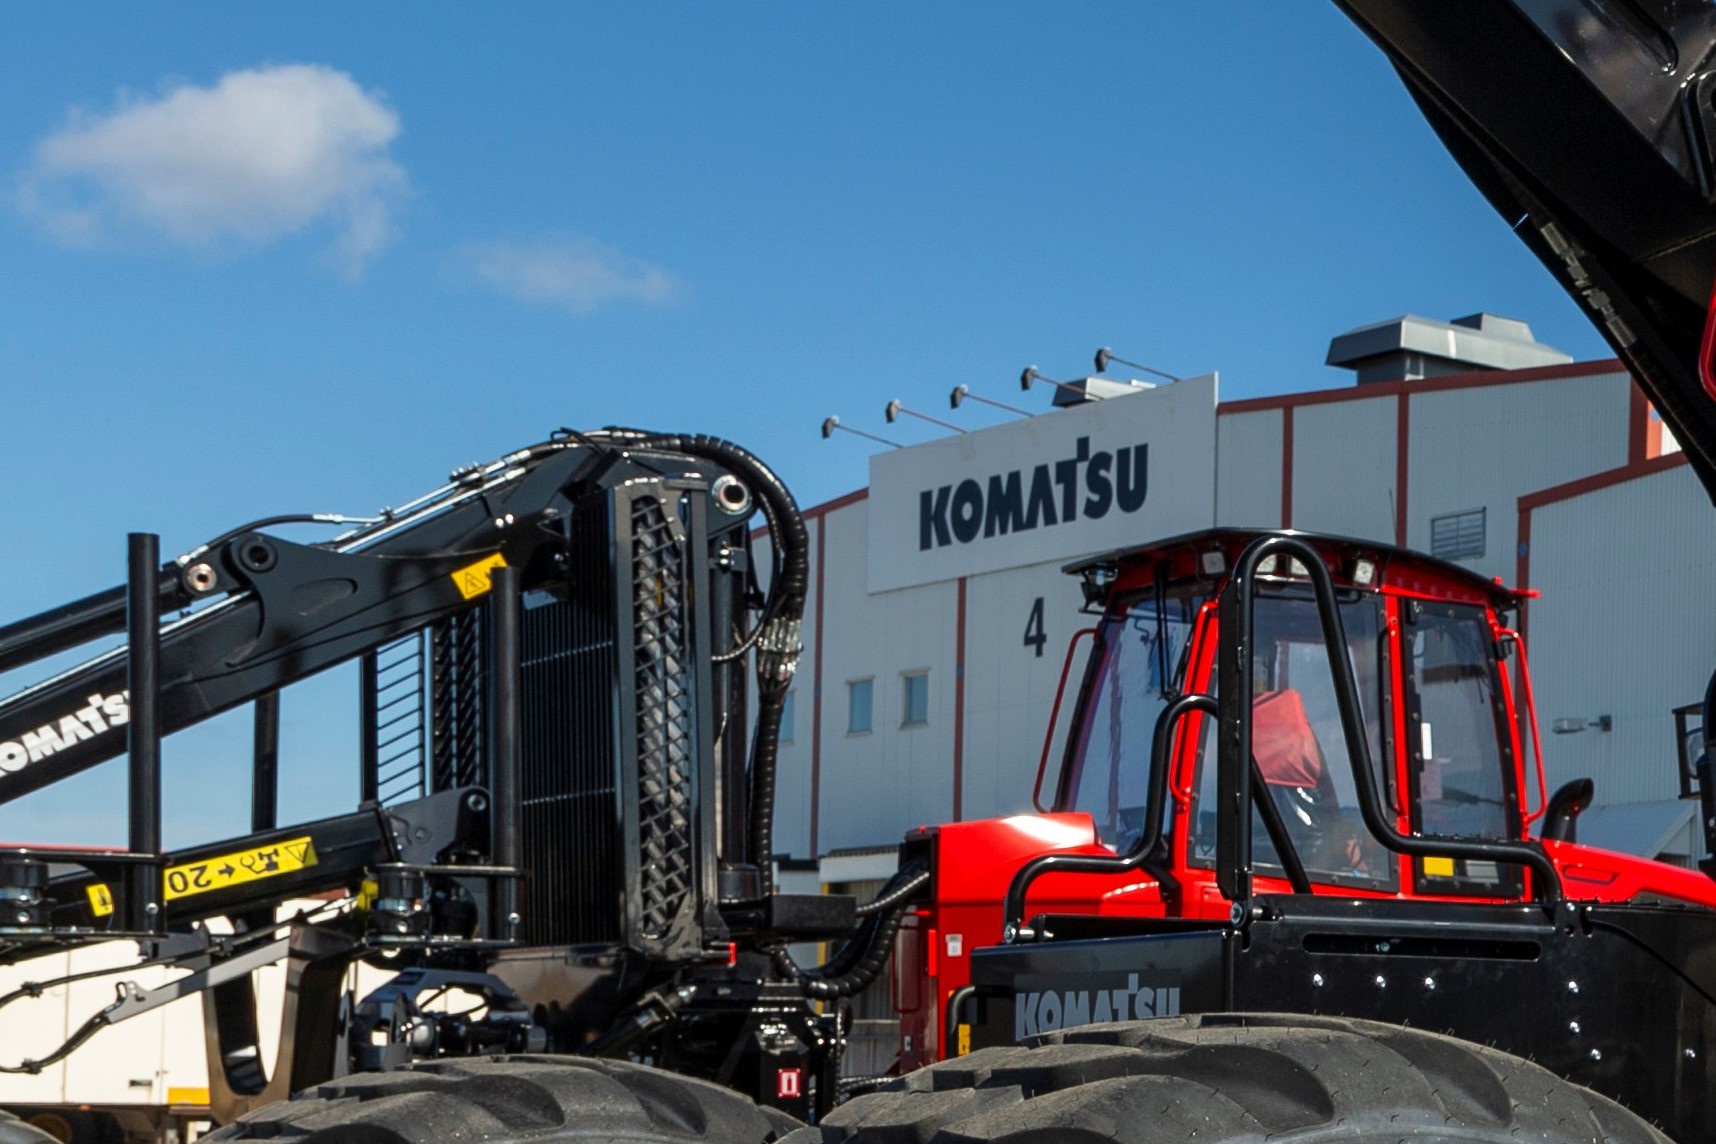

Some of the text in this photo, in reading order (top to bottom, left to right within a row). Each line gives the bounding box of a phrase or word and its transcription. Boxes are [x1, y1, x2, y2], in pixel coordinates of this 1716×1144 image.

[919, 435, 1149, 552] KOMATSU
[1023, 596, 1048, 659] 4
[0, 689, 130, 778] OMATS
[167, 864, 213, 894] 20
